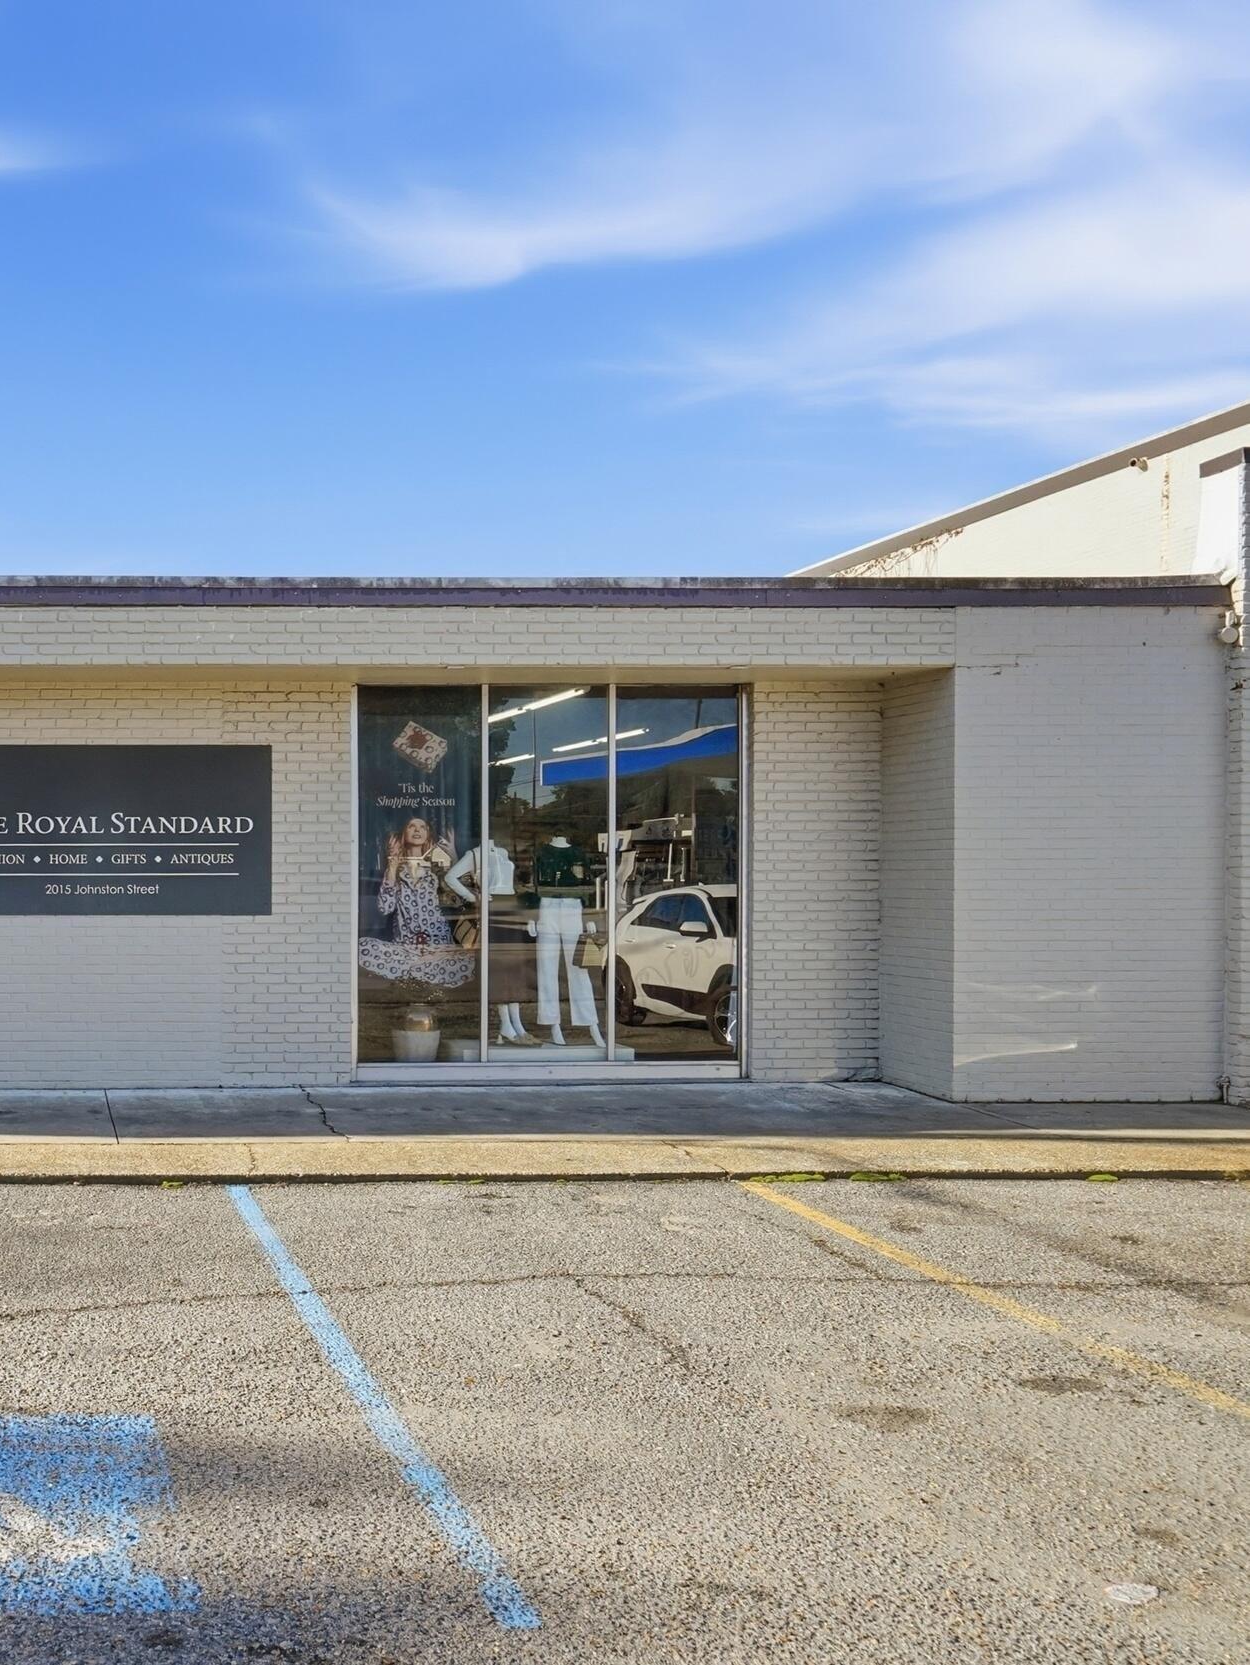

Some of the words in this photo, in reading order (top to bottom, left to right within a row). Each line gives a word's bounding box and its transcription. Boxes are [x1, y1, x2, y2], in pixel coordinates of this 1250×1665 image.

[418, 782, 435, 793] the
[376, 795, 420, 808] Shopping
[421, 796, 456, 807] Season
[15, 812, 105, 835] ROYAL
[110, 811, 254, 834] STANDARD
[49, 853, 88, 865] HOME
[110, 853, 147, 865] GIFTS
[169, 853, 235, 867] ANTIQUES
[44, 884, 72, 895] 2015
[73, 884, 125, 895] Johnston
[126, 883, 160, 895] Street
